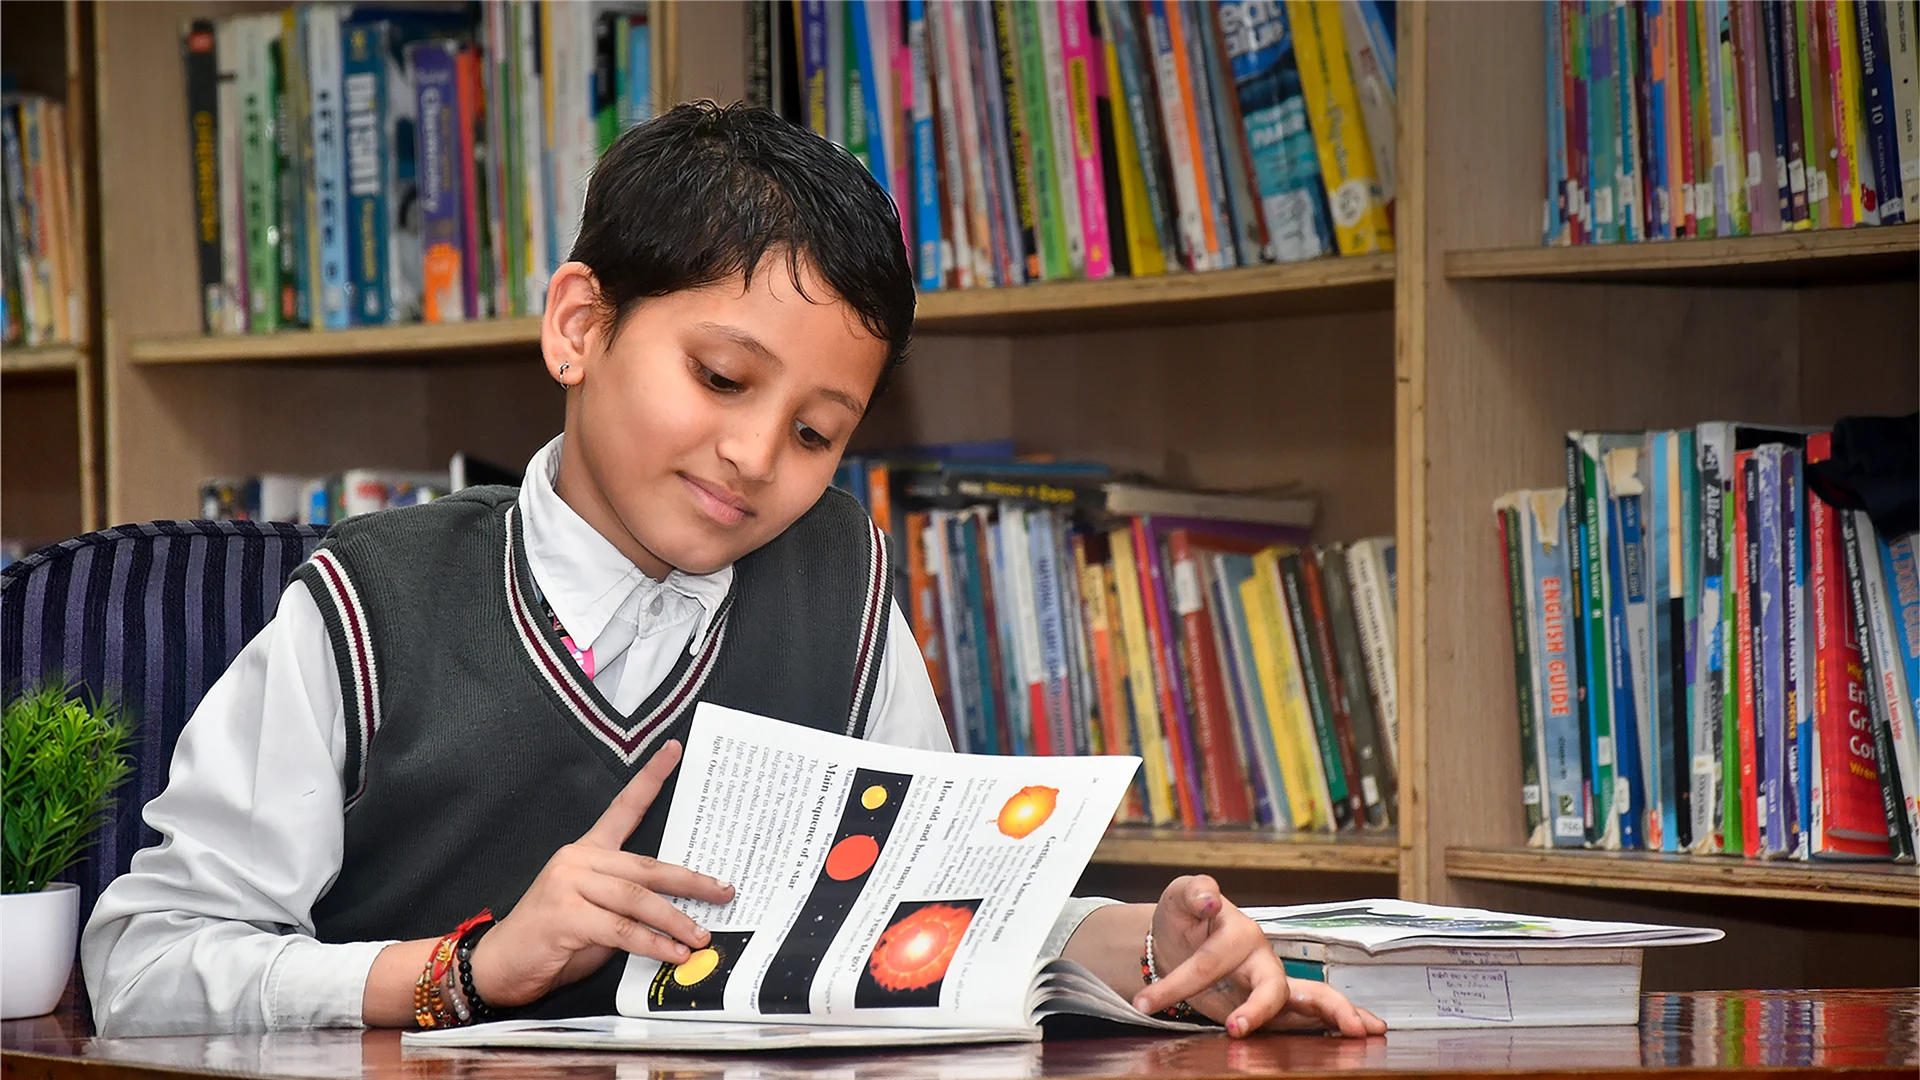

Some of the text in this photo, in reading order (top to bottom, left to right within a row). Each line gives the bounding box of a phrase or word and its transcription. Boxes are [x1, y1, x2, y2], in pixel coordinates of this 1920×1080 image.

[1871, 104, 1883, 125] 10
[1845, 539, 1860, 578] Sample
[1812, 497, 1827, 650] nglish Grammar & Composition
[1037, 557, 1054, 613] NATIONAL
[1851, 578, 1867, 625] Question
[1043, 616, 1058, 655] TALENT
[1541, 576, 1570, 715] ENGLISH GUIDE
[1857, 626, 1871, 663] Papers
[735, 740, 747, 760] light
[746, 744, 759, 765] Then
[785, 751, 794, 762] of
[706, 758, 717, 777] Our
[730, 761, 740, 778] and
[742, 765, 752, 779] the
[766, 749, 784, 780] bulging
[783, 762, 791, 770] a
[791, 754, 805, 785] perhaps
[806, 758, 819, 774] The
[701, 778, 711, 794] sun
[738, 779, 749, 794] hot
[778, 771, 789, 787] star.
[800, 776, 812, 797] main
[820, 762, 838, 792] Main
[699, 794, 709, 803] is
[721, 779, 736, 812] changes
[763, 779, 774, 798] core
[774, 791, 786, 806] The
[787, 785, 798, 799] the
[833, 768, 854, 817] Main sequence
[696, 737, 734, 862] this stage, the star gives out its
[696, 803, 706, 813] in
[731, 793, 744, 819] centre
[761, 798, 770, 808] in
[782, 798, 793, 818] most
[694, 814, 704, 825] its
[716, 814, 728, 831] into
[726, 746, 770, 886] cause the nebula to shrink and finall
[754, 808, 767, 832] which
[789, 799, 805, 836] sequence
[804, 795, 825, 844] sequence
[687, 826, 698, 849] main
[725, 820, 739, 846] begins
[759, 808, 778, 851] contracting
[771, 818, 789, 855] important
[710, 840, 719, 856] star
[722, 846, 730, 856] to
[781, 838, 793, 859] stage
[799, 846, 809, 859] of
[808, 832, 833, 879] Red giant stage
[681, 850, 692, 867] sequ
[704, 857, 715, 873] that
[716, 856, 727, 876] glow
[738, 832, 761, 890] thermonuclear
[752, 853, 766, 879] nebula
[765, 855, 776, 875] stage
[778, 860, 786, 869] is
[762, 875, 770, 884] in
[773, 870, 783, 883] the
[787, 869, 800, 889] star
[848, 780, 954, 973] How old and how many more years to go?
[747, 880, 758, 894] has
[757, 883, 768, 895] the
[990, 835, 1056, 942] Getting to know the sun
[752, 895, 764, 907] life
[761, 884, 779, 911] longest
